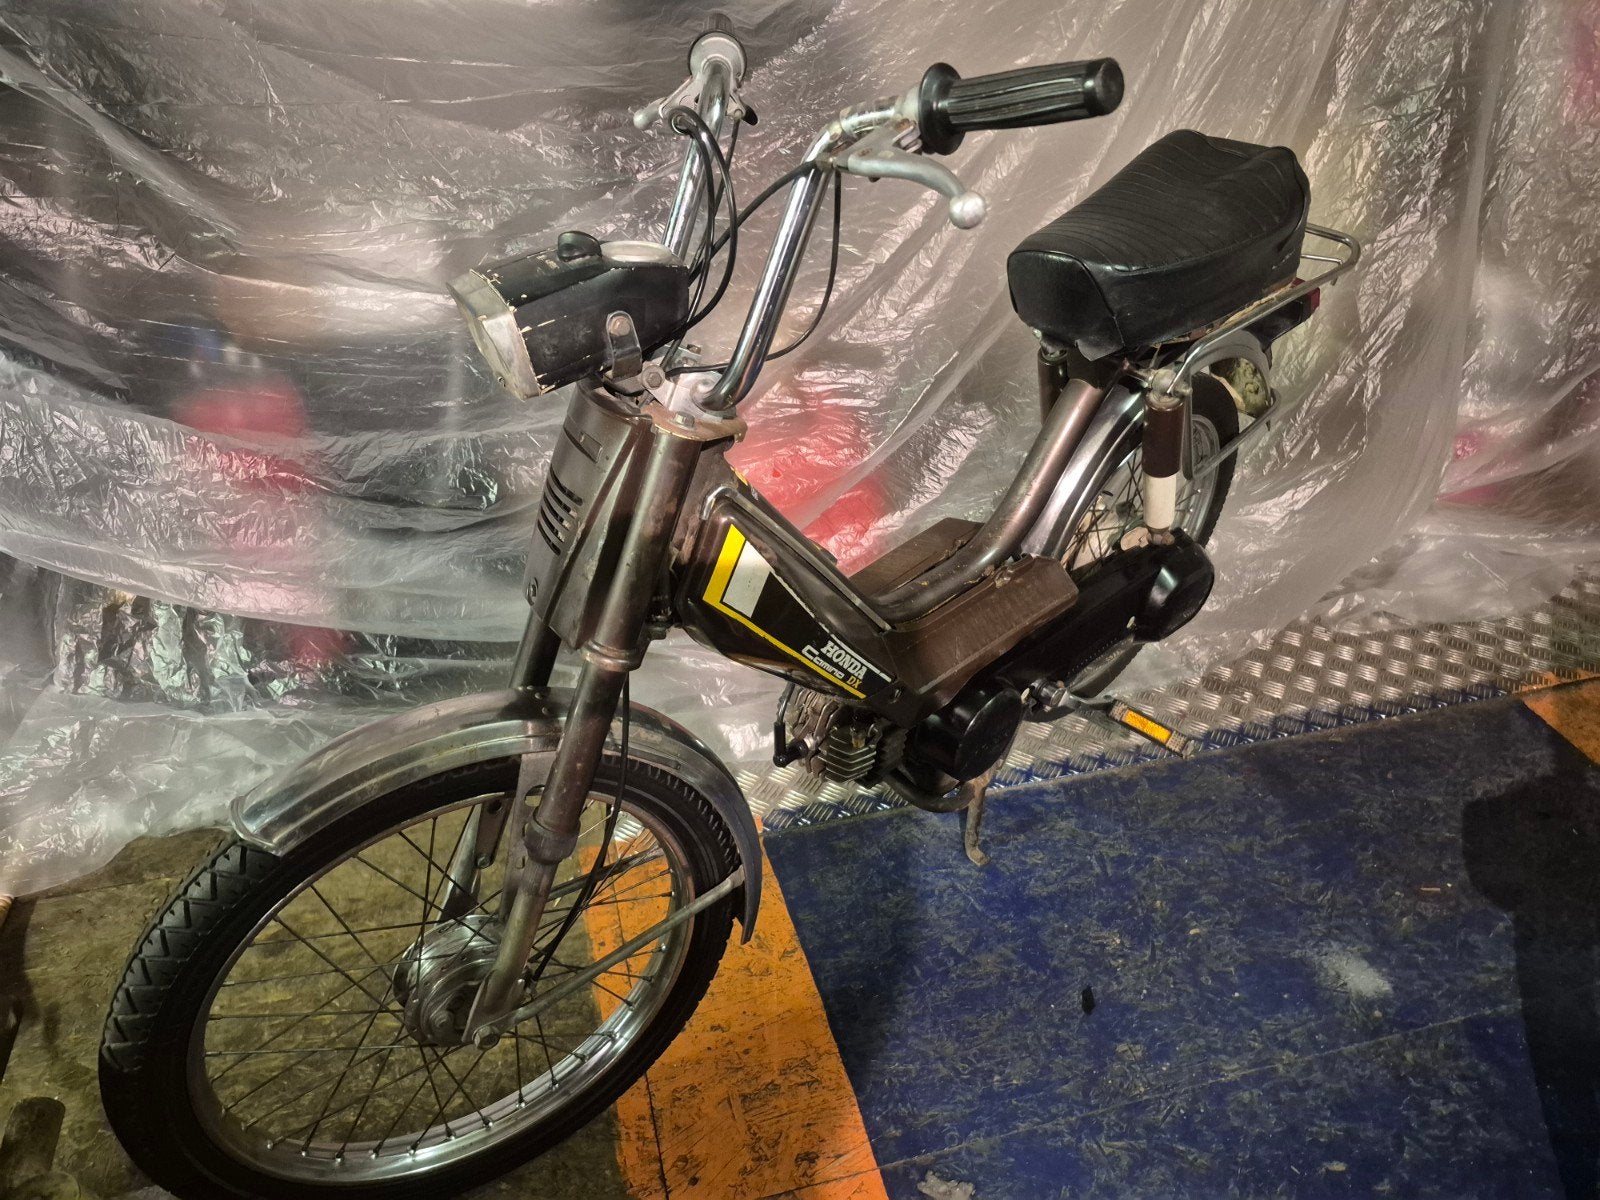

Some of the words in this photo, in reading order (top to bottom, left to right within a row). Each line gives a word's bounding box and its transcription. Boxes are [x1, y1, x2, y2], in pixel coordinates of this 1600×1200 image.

[801, 644, 845, 679] Camino
[846, 675, 863, 689] DX
[820, 640, 868, 680] HONDA
